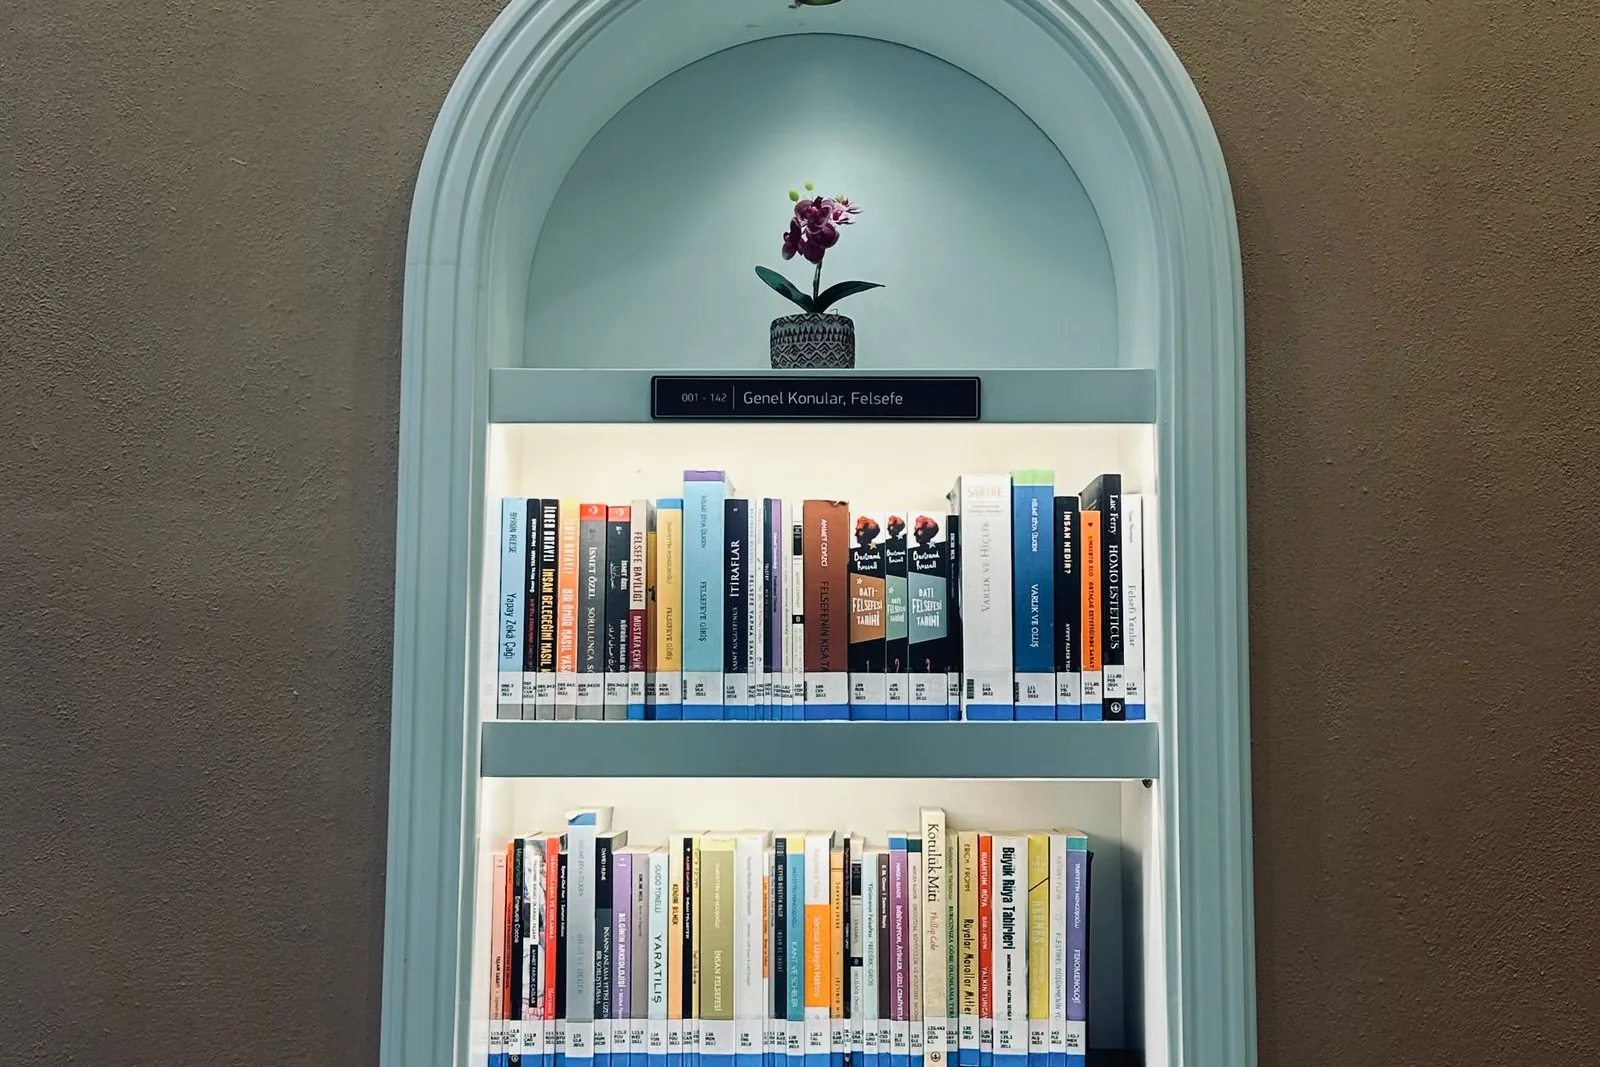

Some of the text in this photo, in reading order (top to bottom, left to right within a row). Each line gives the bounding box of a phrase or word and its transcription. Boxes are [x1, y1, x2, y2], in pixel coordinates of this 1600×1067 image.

[682, 393, 698, 402] 001
[710, 393, 727, 402] 142
[743, 391, 783, 405] Genel
[788, 391, 846, 406] Konular,
[851, 391, 903, 405] Felsefe
[820, 518, 828, 542] AHMET
[1064, 511, 1073, 539] İNSAN
[543, 531, 556, 562] ORTAYLI
[633, 531, 643, 563] FELSEFE
[1064, 542, 1073, 574] NEDİR?
[542, 569, 556, 593] İNSAN
[730, 540, 740, 598] İTİRAFLAR
[1108, 494, 1120, 650] Luc Ferry HOMO ESTETICUS
[504, 593, 517, 617] Yapay
[587, 546, 598, 661] İSMET ÖZEL SORULUNCA
[852, 598, 882, 613] FELSEFESİ
[912, 598, 942, 613] FELSEFESİ
[918, 588, 934, 598] BATI
[980, 577, 990, 612] VARLIK
[562, 604, 574, 626] ÖMÜR
[819, 581, 830, 636] FELSEFENİN
[857, 611, 880, 626] TARİHİ
[916, 612, 939, 627] TARİHİ
[1031, 614, 1038, 626] VE
[1127, 585, 1137, 647] Felsefi Yazılar
[561, 629, 572, 652] NASIL
[633, 615, 642, 648] MUSTAFA
[698, 622, 708, 642] GİRİŞ
[1030, 627, 1038, 648] OLUŞ
[503, 642, 516, 660] Çağı
[540, 643, 552, 666] NASIL
[630, 650, 643, 669] ÇEVİK
[820, 639, 829, 660] KISA
[654, 864, 662, 886] GUIDO
[928, 824, 943, 951] Kötülük Miti Phillip Cole
[1000, 847, 1016, 950] Büyük Rüya Tabirleri
[962, 919, 974, 949] Rüyalar
[618, 912, 626, 988] BİLGİNİN ARKEOLOJİSİ
[577, 968, 585, 994] DEĞER
[652, 934, 662, 1003] YARATILIŞ
[714, 950, 722, 1011] İNSAN FELSEFESİ
[791, 966, 798, 976] VE
[963, 952, 975, 987] Masallar
[1054, 932, 1062, 1009] ELEŞTİREL DÜŞÜNMENİN
[1071, 949, 1081, 1004] FENOMENOLOJİ
